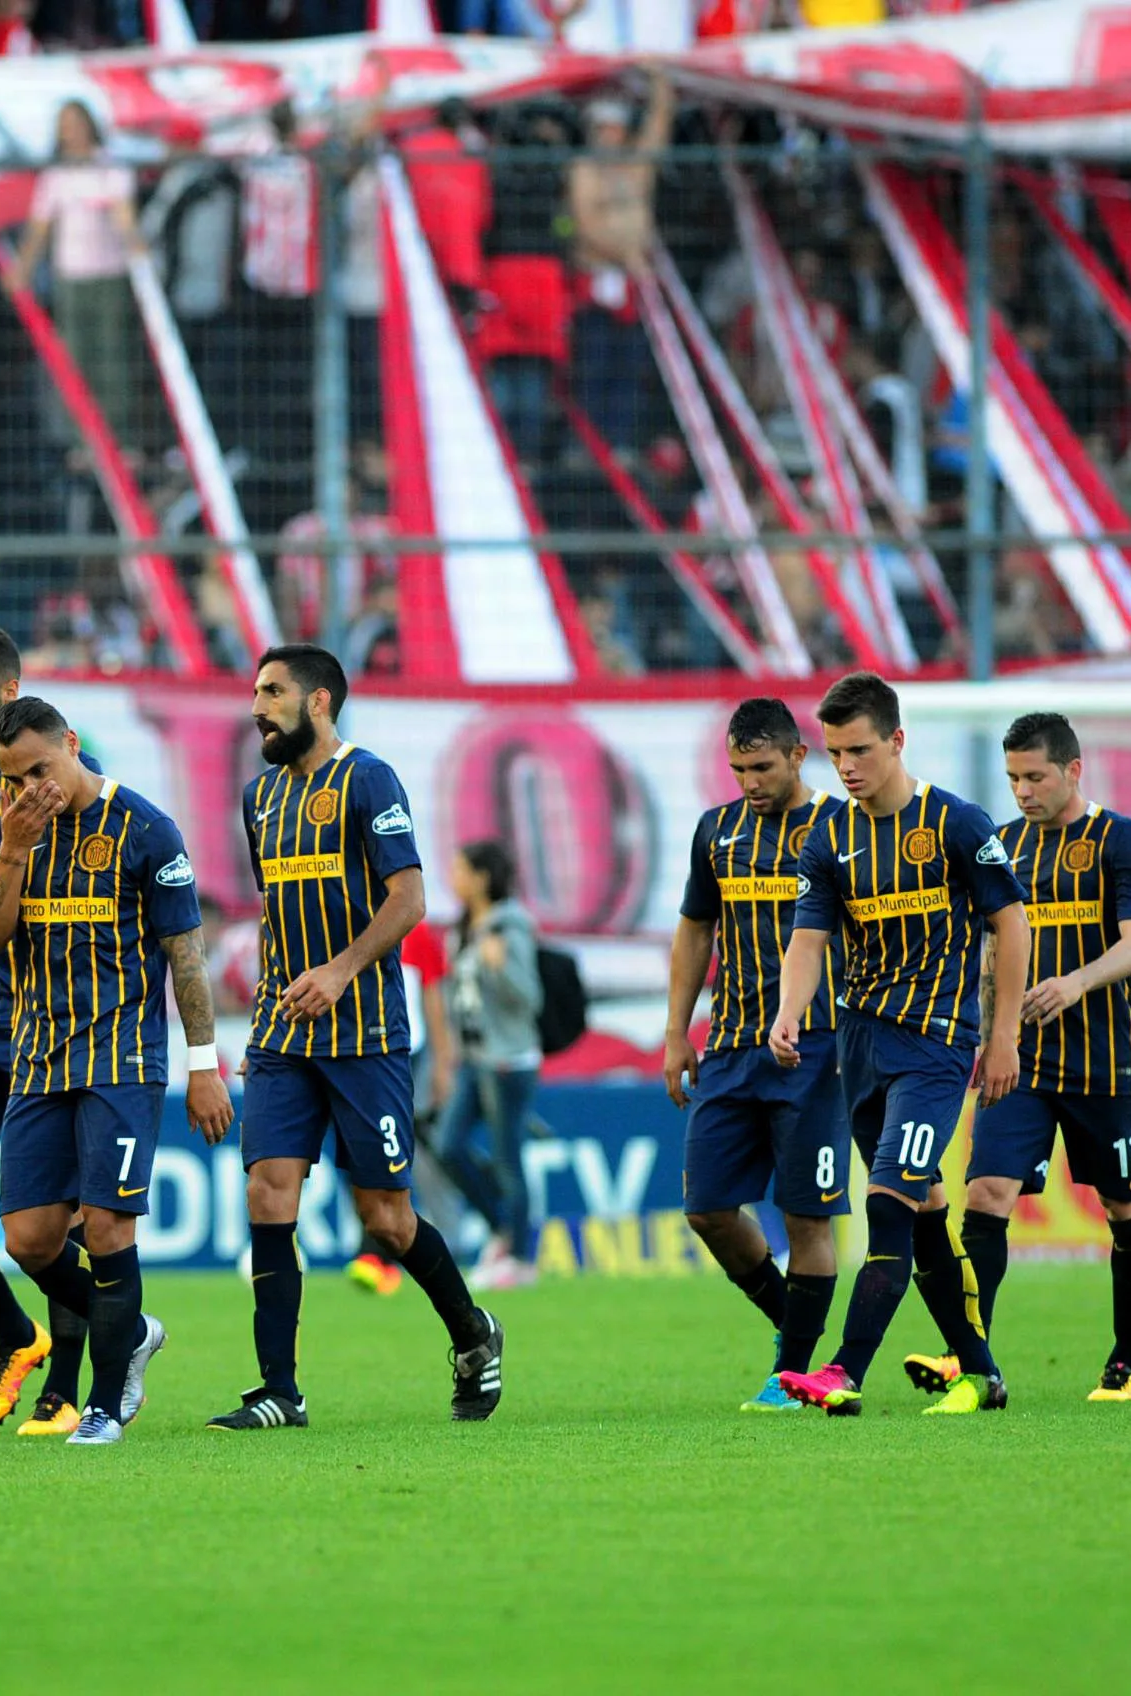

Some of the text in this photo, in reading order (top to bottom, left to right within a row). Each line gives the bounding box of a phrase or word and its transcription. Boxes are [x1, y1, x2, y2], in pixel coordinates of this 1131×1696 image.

[280, 856, 339, 875] Municipal
[20, 901, 111, 919] anco Municipal
[879, 889, 945, 913] Municipal
[1037, 903, 1098, 921] Municipal
[380, 1115, 400, 1158] 3
[898, 1121, 935, 1168] 10
[116, 1137, 136, 1181] 7
[816, 1145, 834, 1189] 8
[1112, 1137, 1131, 1178] 1
